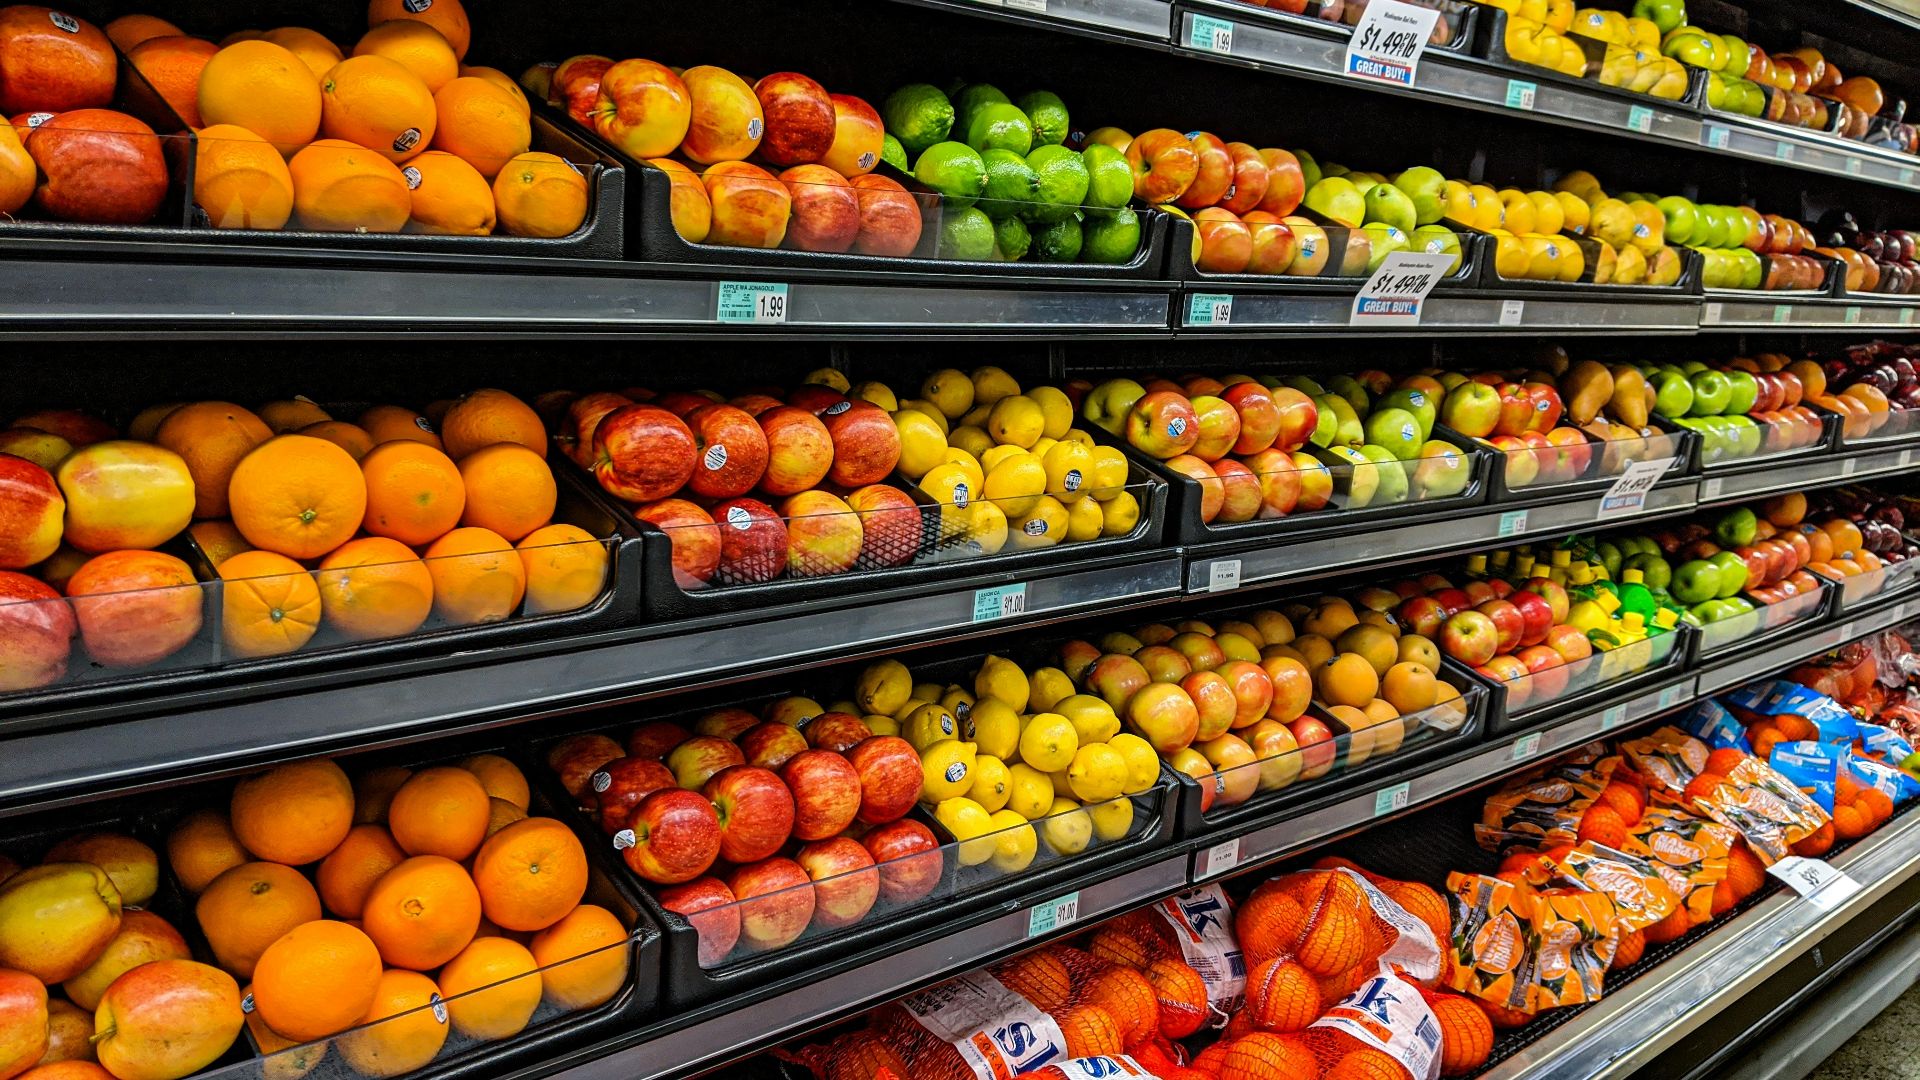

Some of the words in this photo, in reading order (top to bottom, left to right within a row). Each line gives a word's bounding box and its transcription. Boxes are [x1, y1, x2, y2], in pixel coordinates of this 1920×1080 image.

[1216, 31, 1230, 51] 1.99
[1360, 23, 1404, 55] $1.49
[1356, 60, 1385, 77] GREAT
[1384, 66, 1406, 80] BUY!
[1371, 273, 1416, 294] $1.49
[760, 295, 784, 317] 1.99
[1215, 304, 1230, 321] 1.99
[1363, 301, 1392, 313] GREAT
[1391, 302, 1413, 313] BUY!
